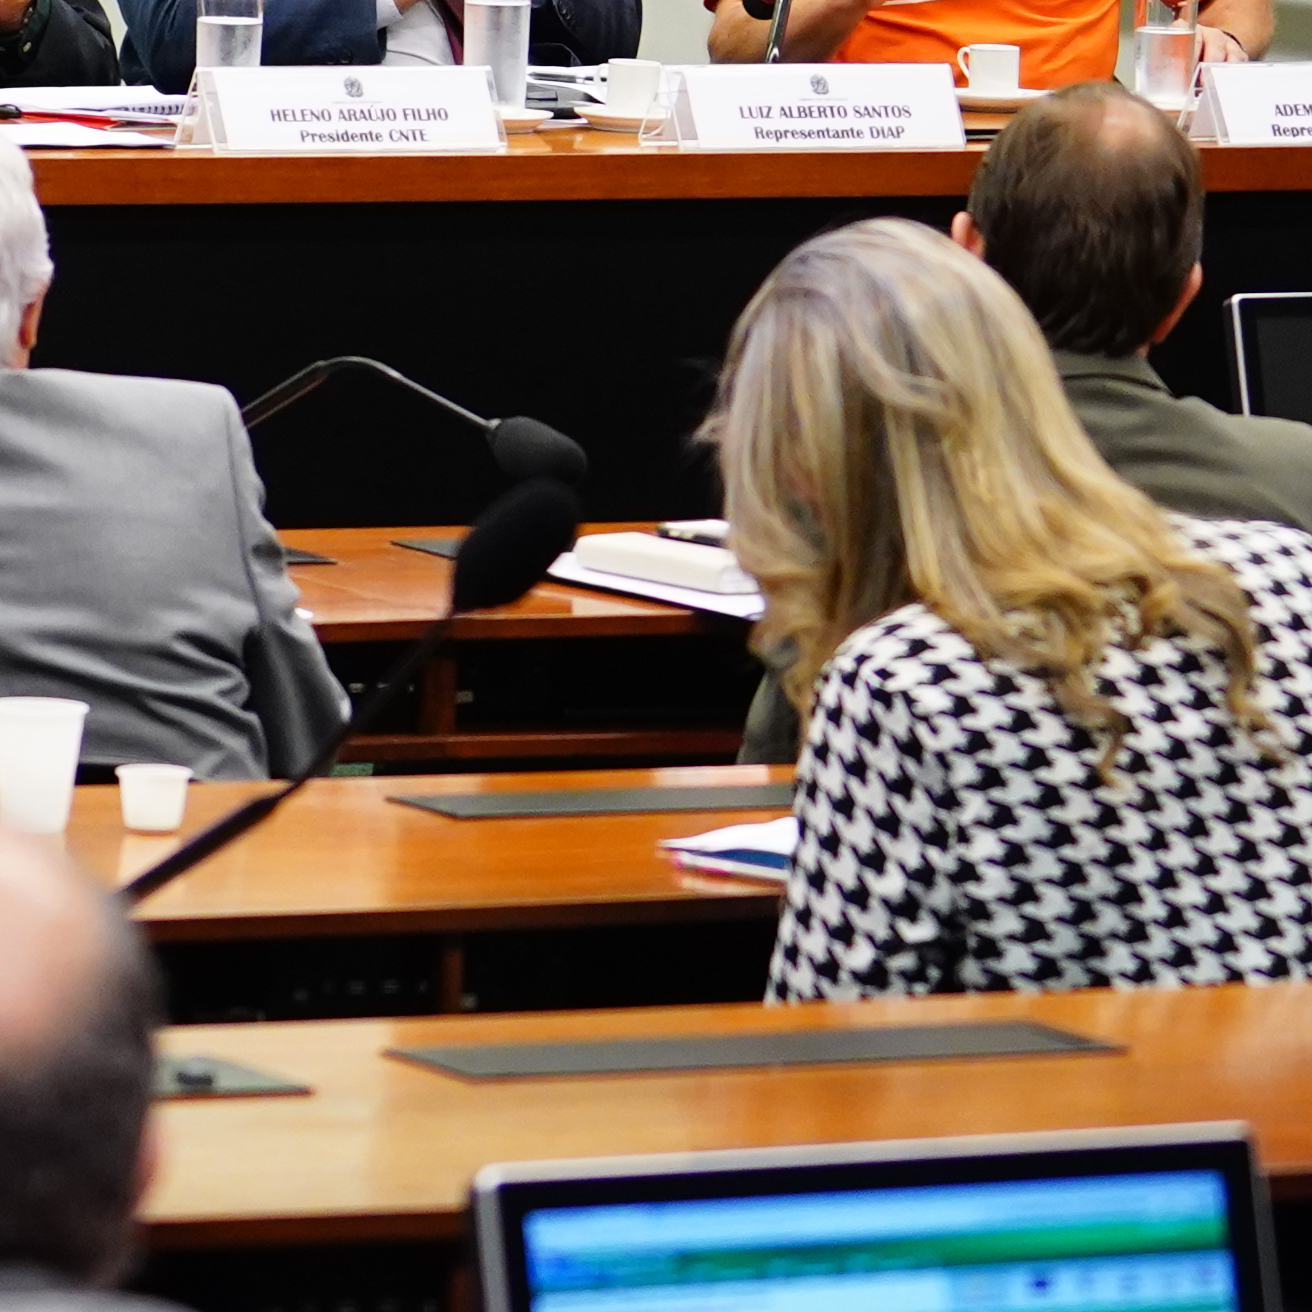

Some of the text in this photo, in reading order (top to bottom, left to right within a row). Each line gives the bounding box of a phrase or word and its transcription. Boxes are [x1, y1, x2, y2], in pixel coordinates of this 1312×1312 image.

[269, 104, 449, 123] HELENO ARAÚJO FILHO
[738, 105, 912, 120] LUIZ ALBERTO SANTOS
[299, 128, 428, 143] Presidente CNTE
[753, 125, 905, 143] Representante DIAP
